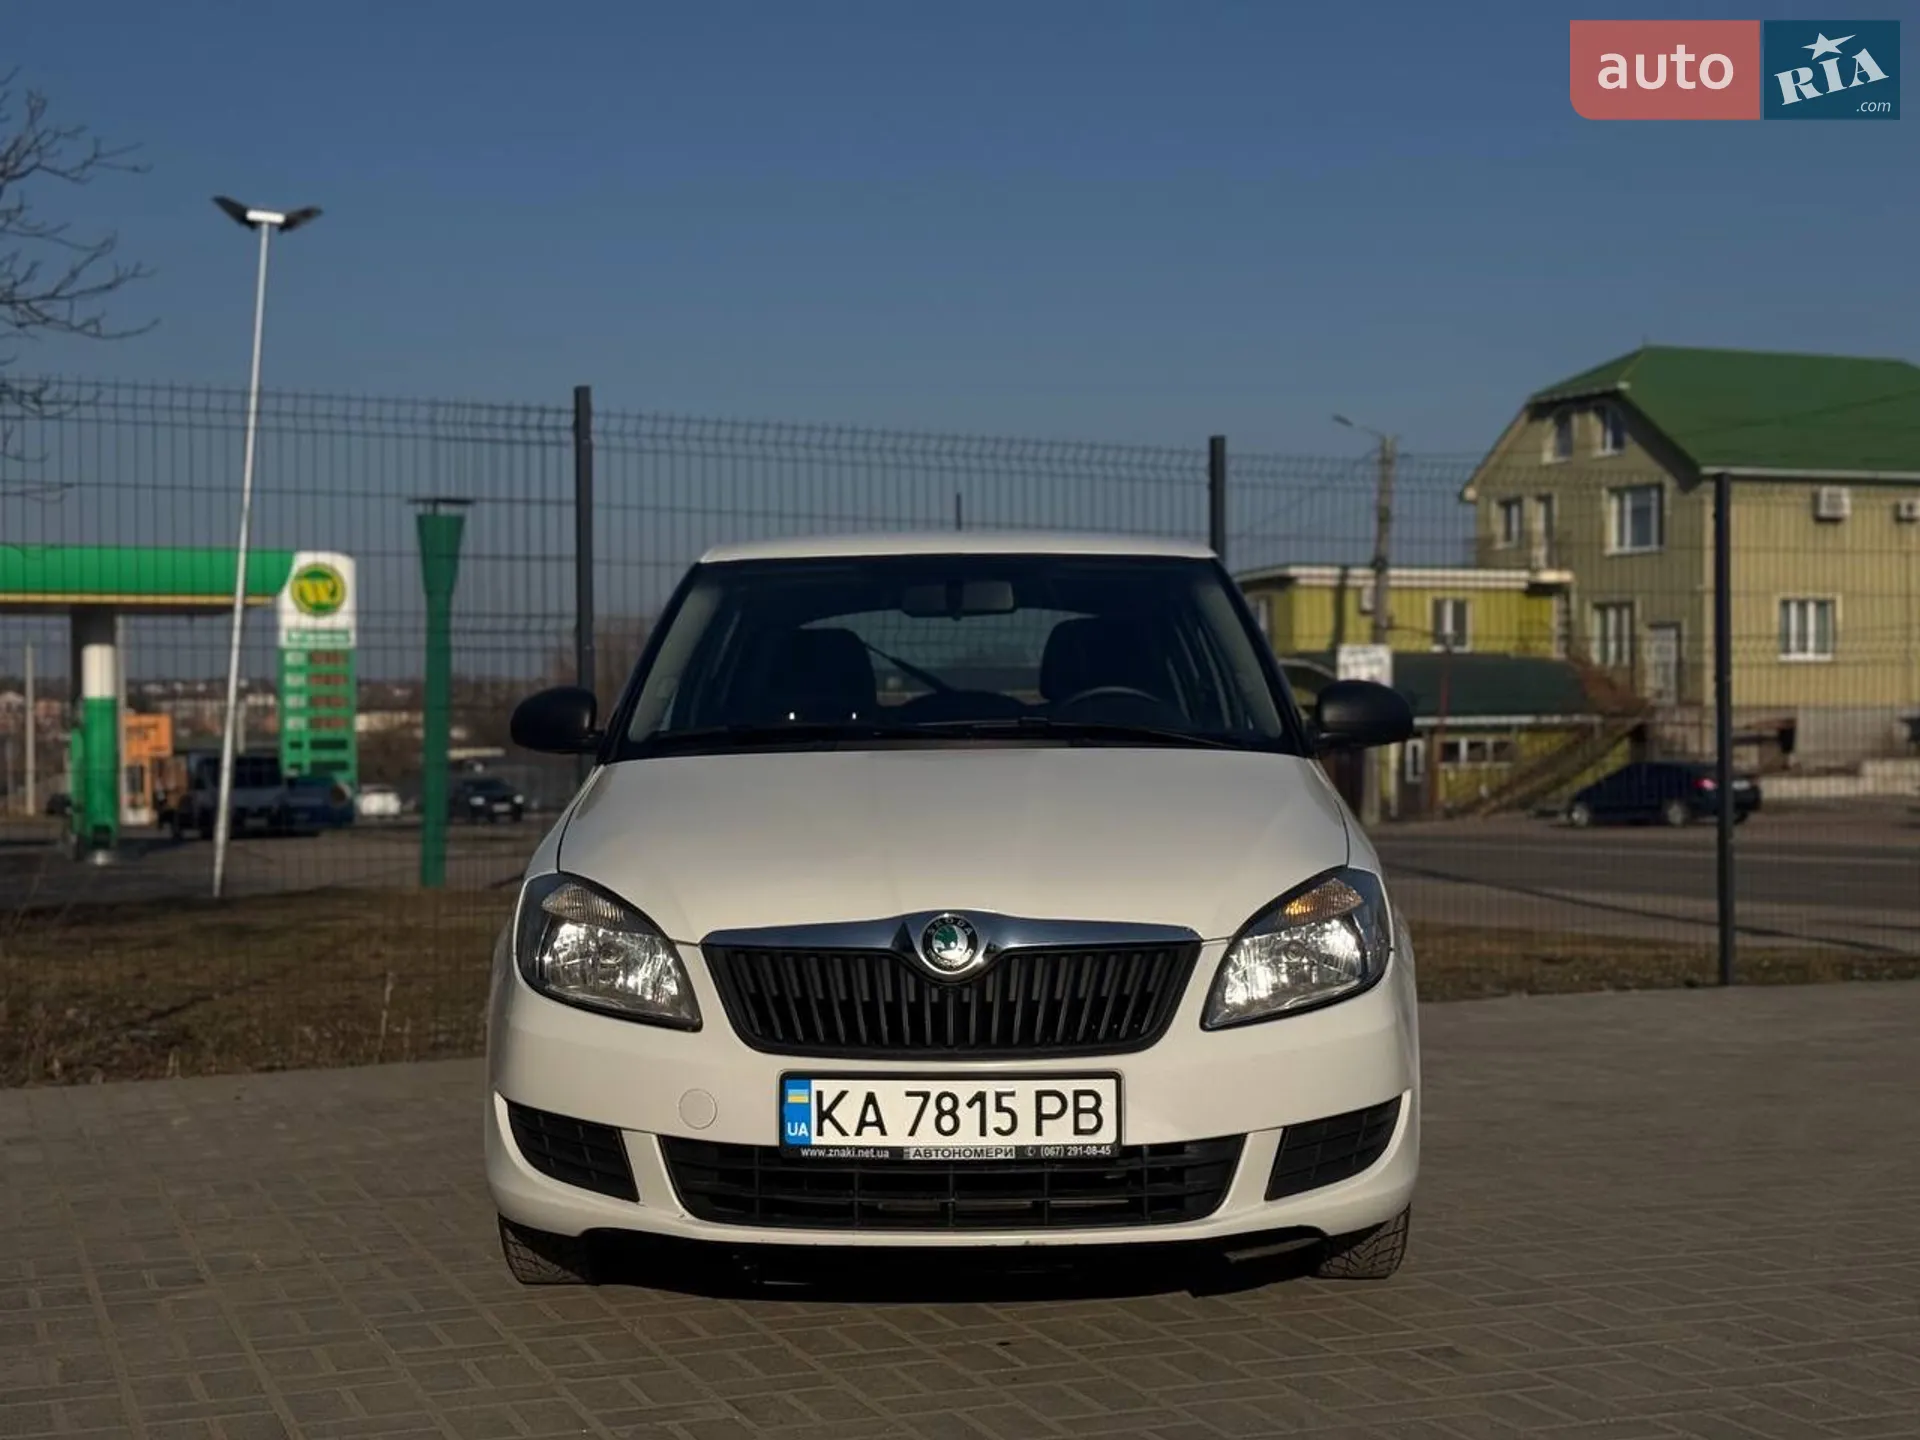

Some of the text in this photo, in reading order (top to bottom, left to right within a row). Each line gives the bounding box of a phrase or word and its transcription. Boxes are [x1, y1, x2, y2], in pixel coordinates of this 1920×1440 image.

[815, 1089, 1104, 1137] KA 7815 PB
[787, 1122, 809, 1137] UA
[800, 1147, 890, 1159] www.znaki.net.ua
[911, 1147, 1016, 1159] АВТОНОМЕРИ
